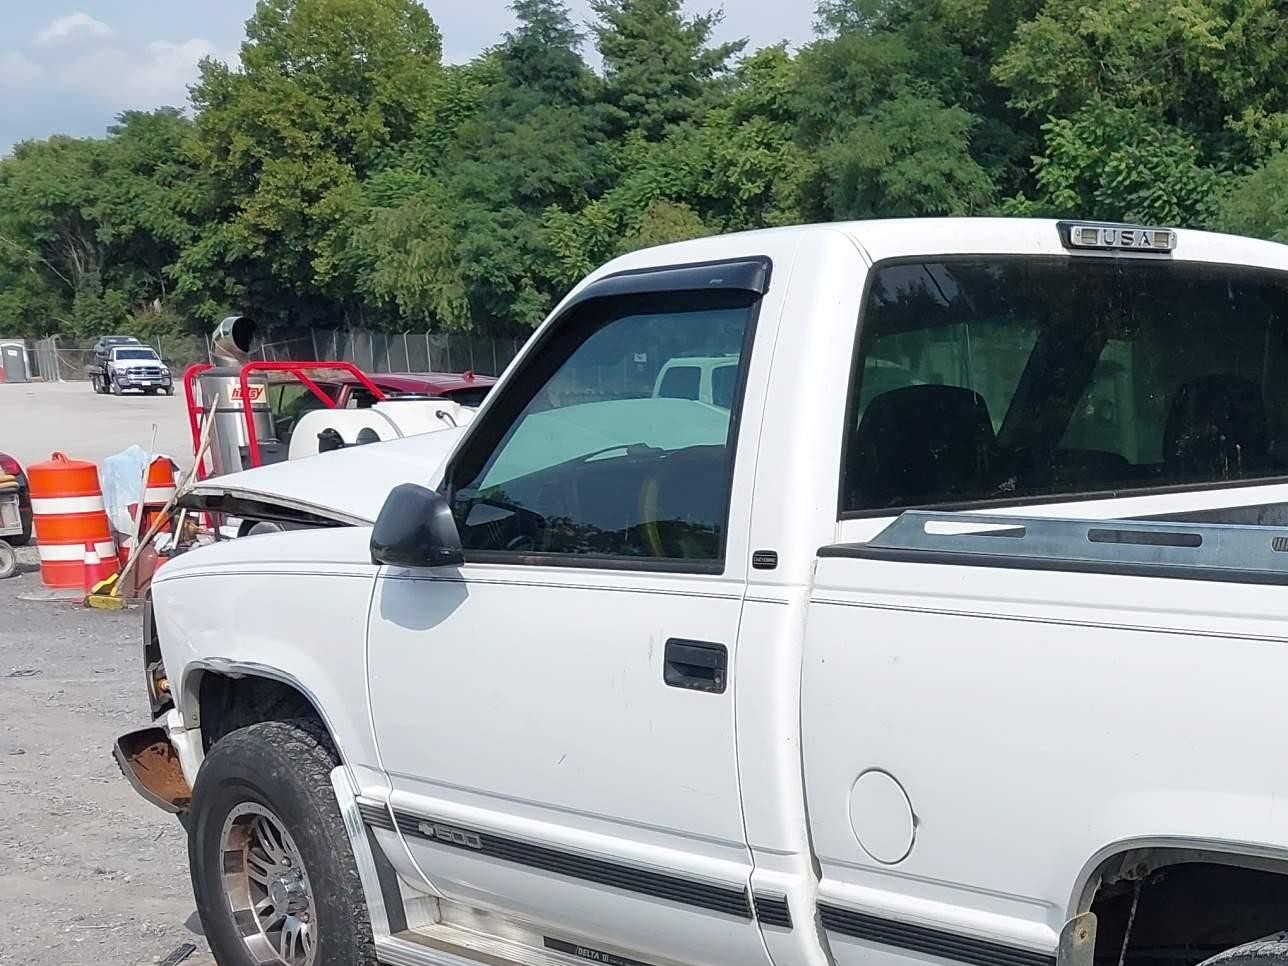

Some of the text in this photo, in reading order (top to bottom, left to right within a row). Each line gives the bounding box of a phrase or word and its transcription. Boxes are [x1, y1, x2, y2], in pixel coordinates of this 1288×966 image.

[1103, 229, 1151, 246] USA
[231, 387, 263, 400] hsy
[578, 947, 600, 960] DELTA
